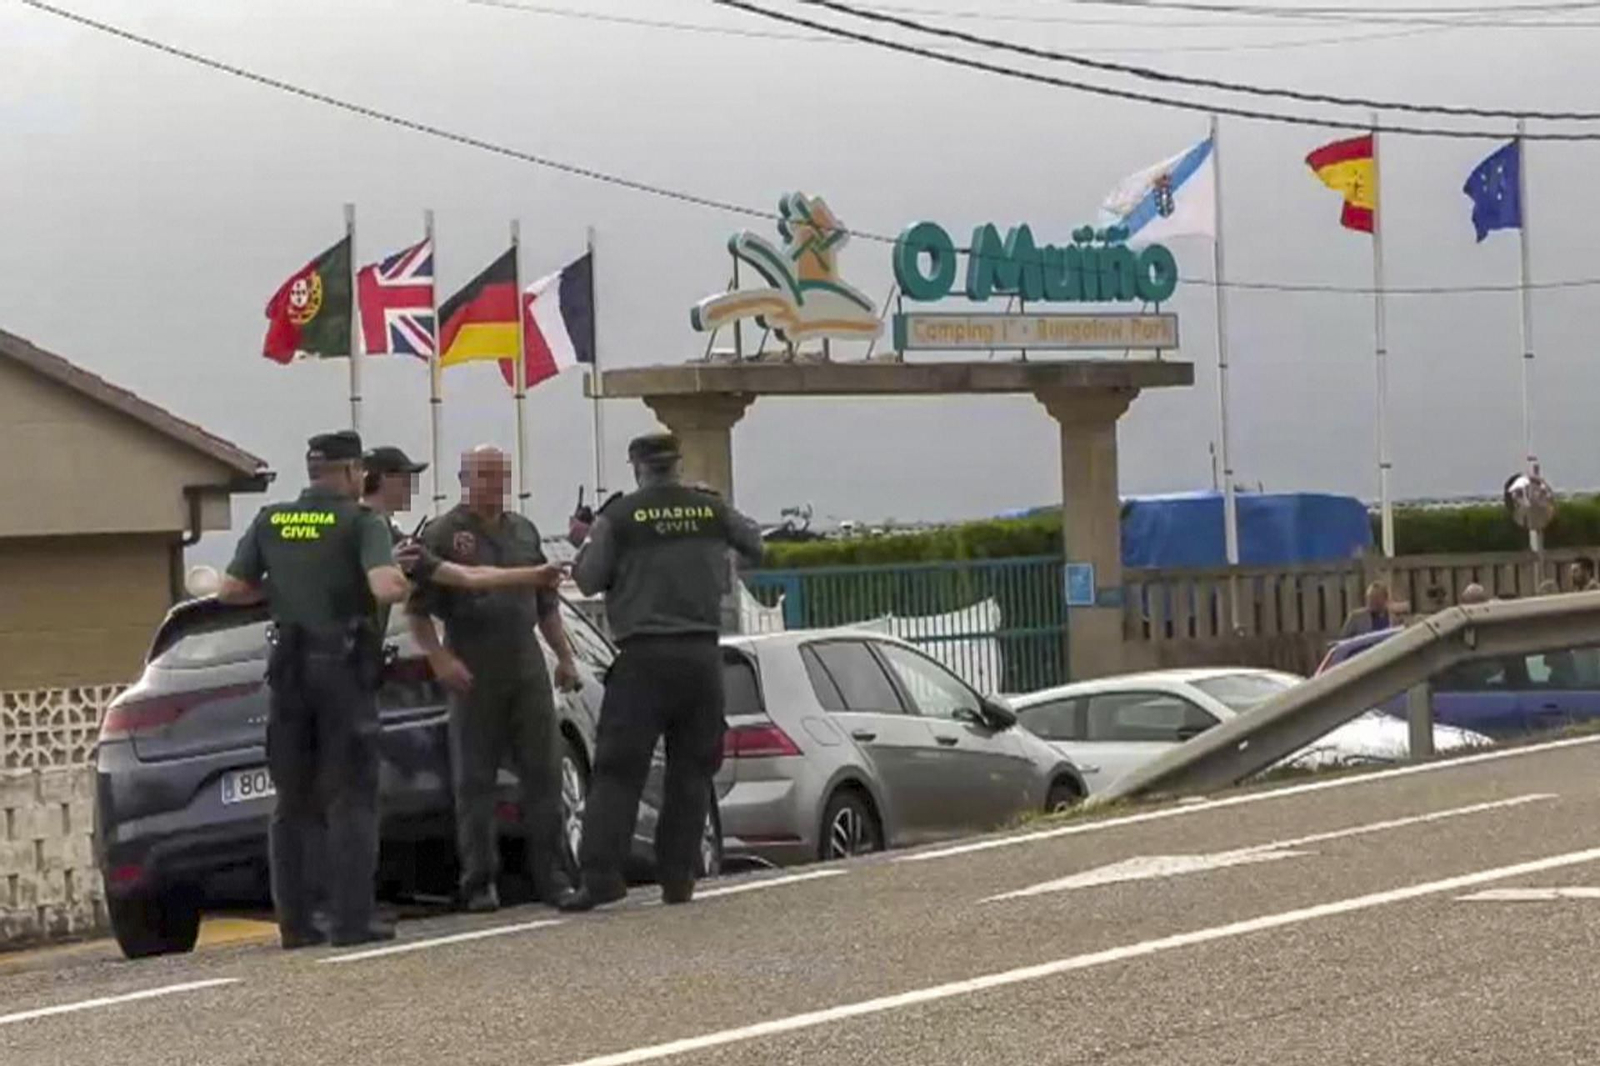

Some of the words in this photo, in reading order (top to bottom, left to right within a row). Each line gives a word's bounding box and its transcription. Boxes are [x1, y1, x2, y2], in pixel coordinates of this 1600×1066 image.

[894, 221, 957, 302] O
[913, 318, 994, 344] Camping
[270, 511, 336, 525] GUARDIA
[633, 505, 715, 523] GUARDIA
[280, 524, 321, 540] CIVIL
[655, 520, 700, 535] CIVIL
